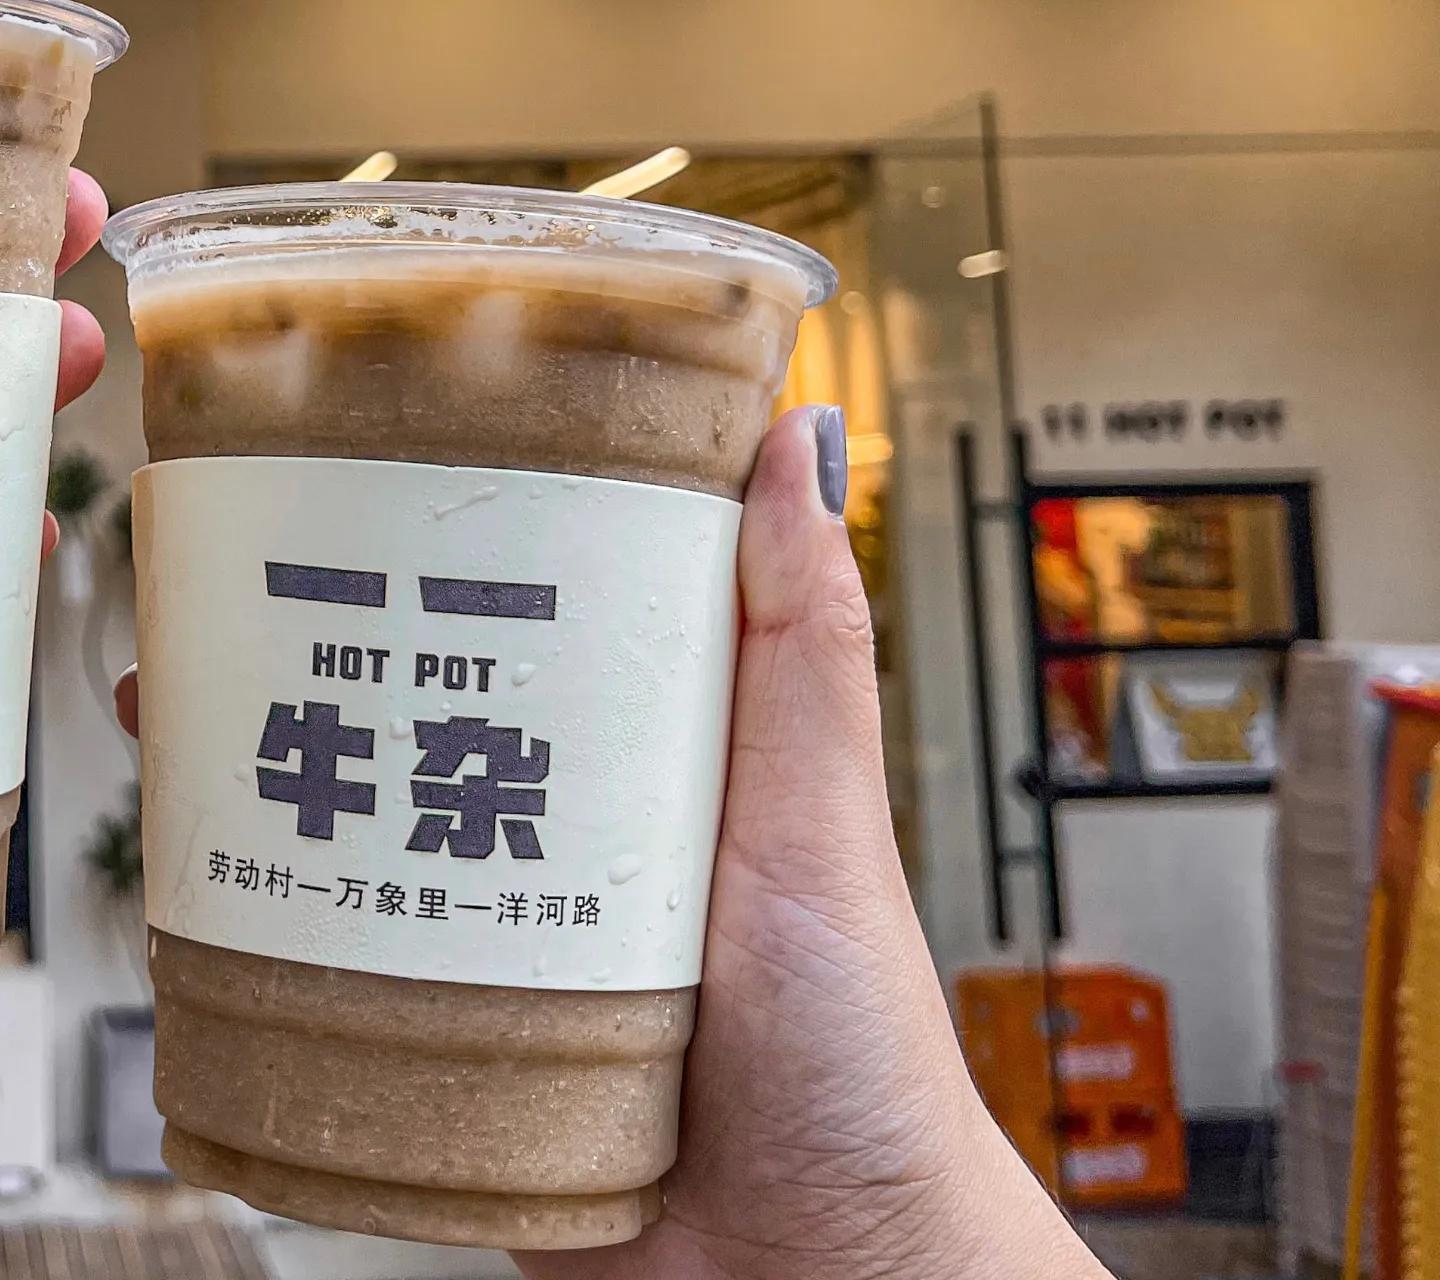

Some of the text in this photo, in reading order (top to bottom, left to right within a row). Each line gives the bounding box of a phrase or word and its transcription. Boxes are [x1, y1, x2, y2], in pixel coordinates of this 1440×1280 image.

[312, 642, 496, 693] HOT POT
[256, 700, 551, 860] 牛杂
